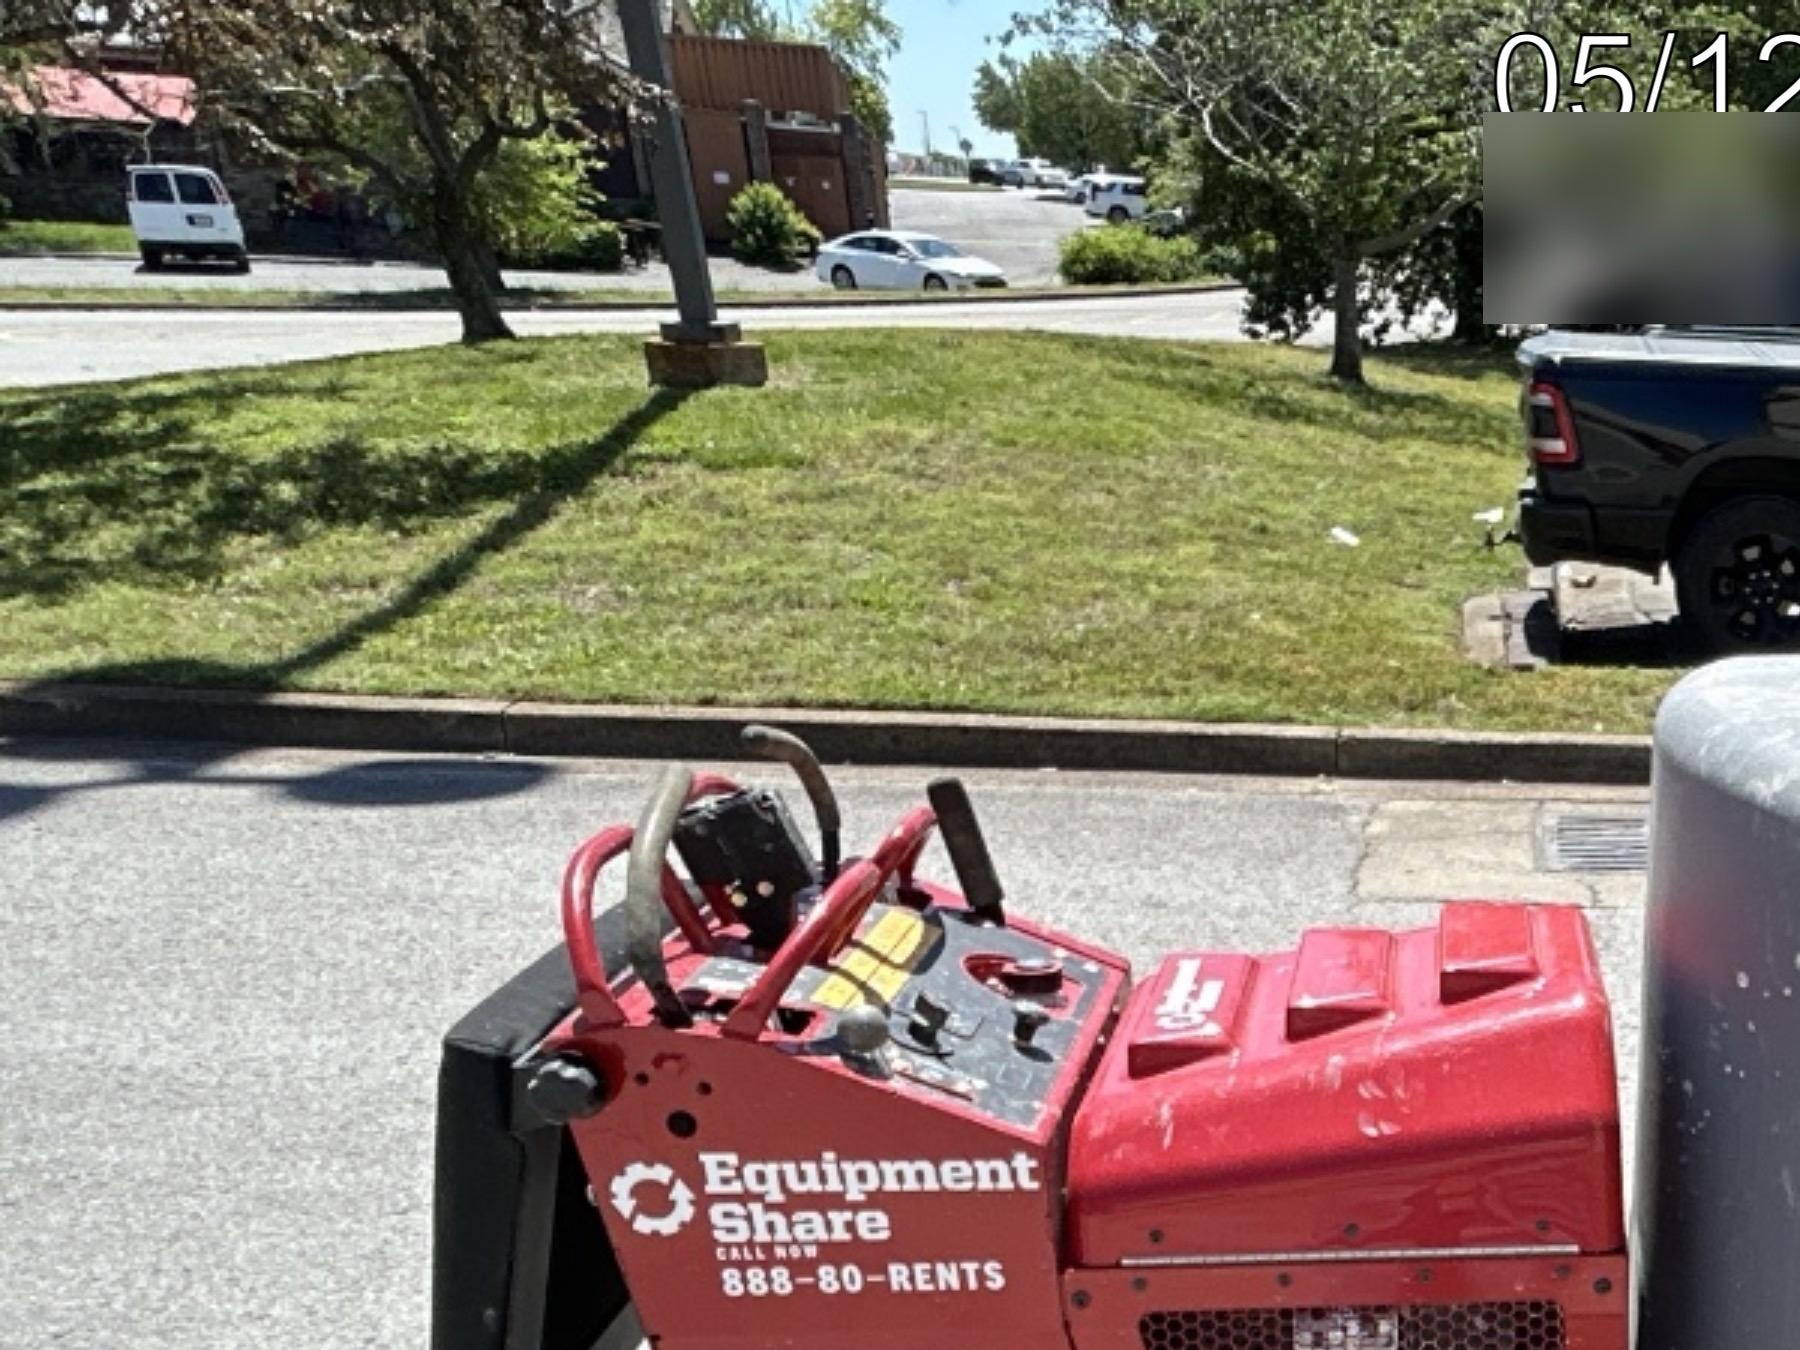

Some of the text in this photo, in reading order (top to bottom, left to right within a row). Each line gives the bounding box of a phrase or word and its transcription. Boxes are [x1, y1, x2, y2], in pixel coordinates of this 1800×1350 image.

[700, 1151, 1041, 1204] Equipment
[708, 1201, 892, 1244] Share
[715, 1243, 818, 1261] CALL NOW
[721, 1260, 1006, 1298] 888-80-RENTS
